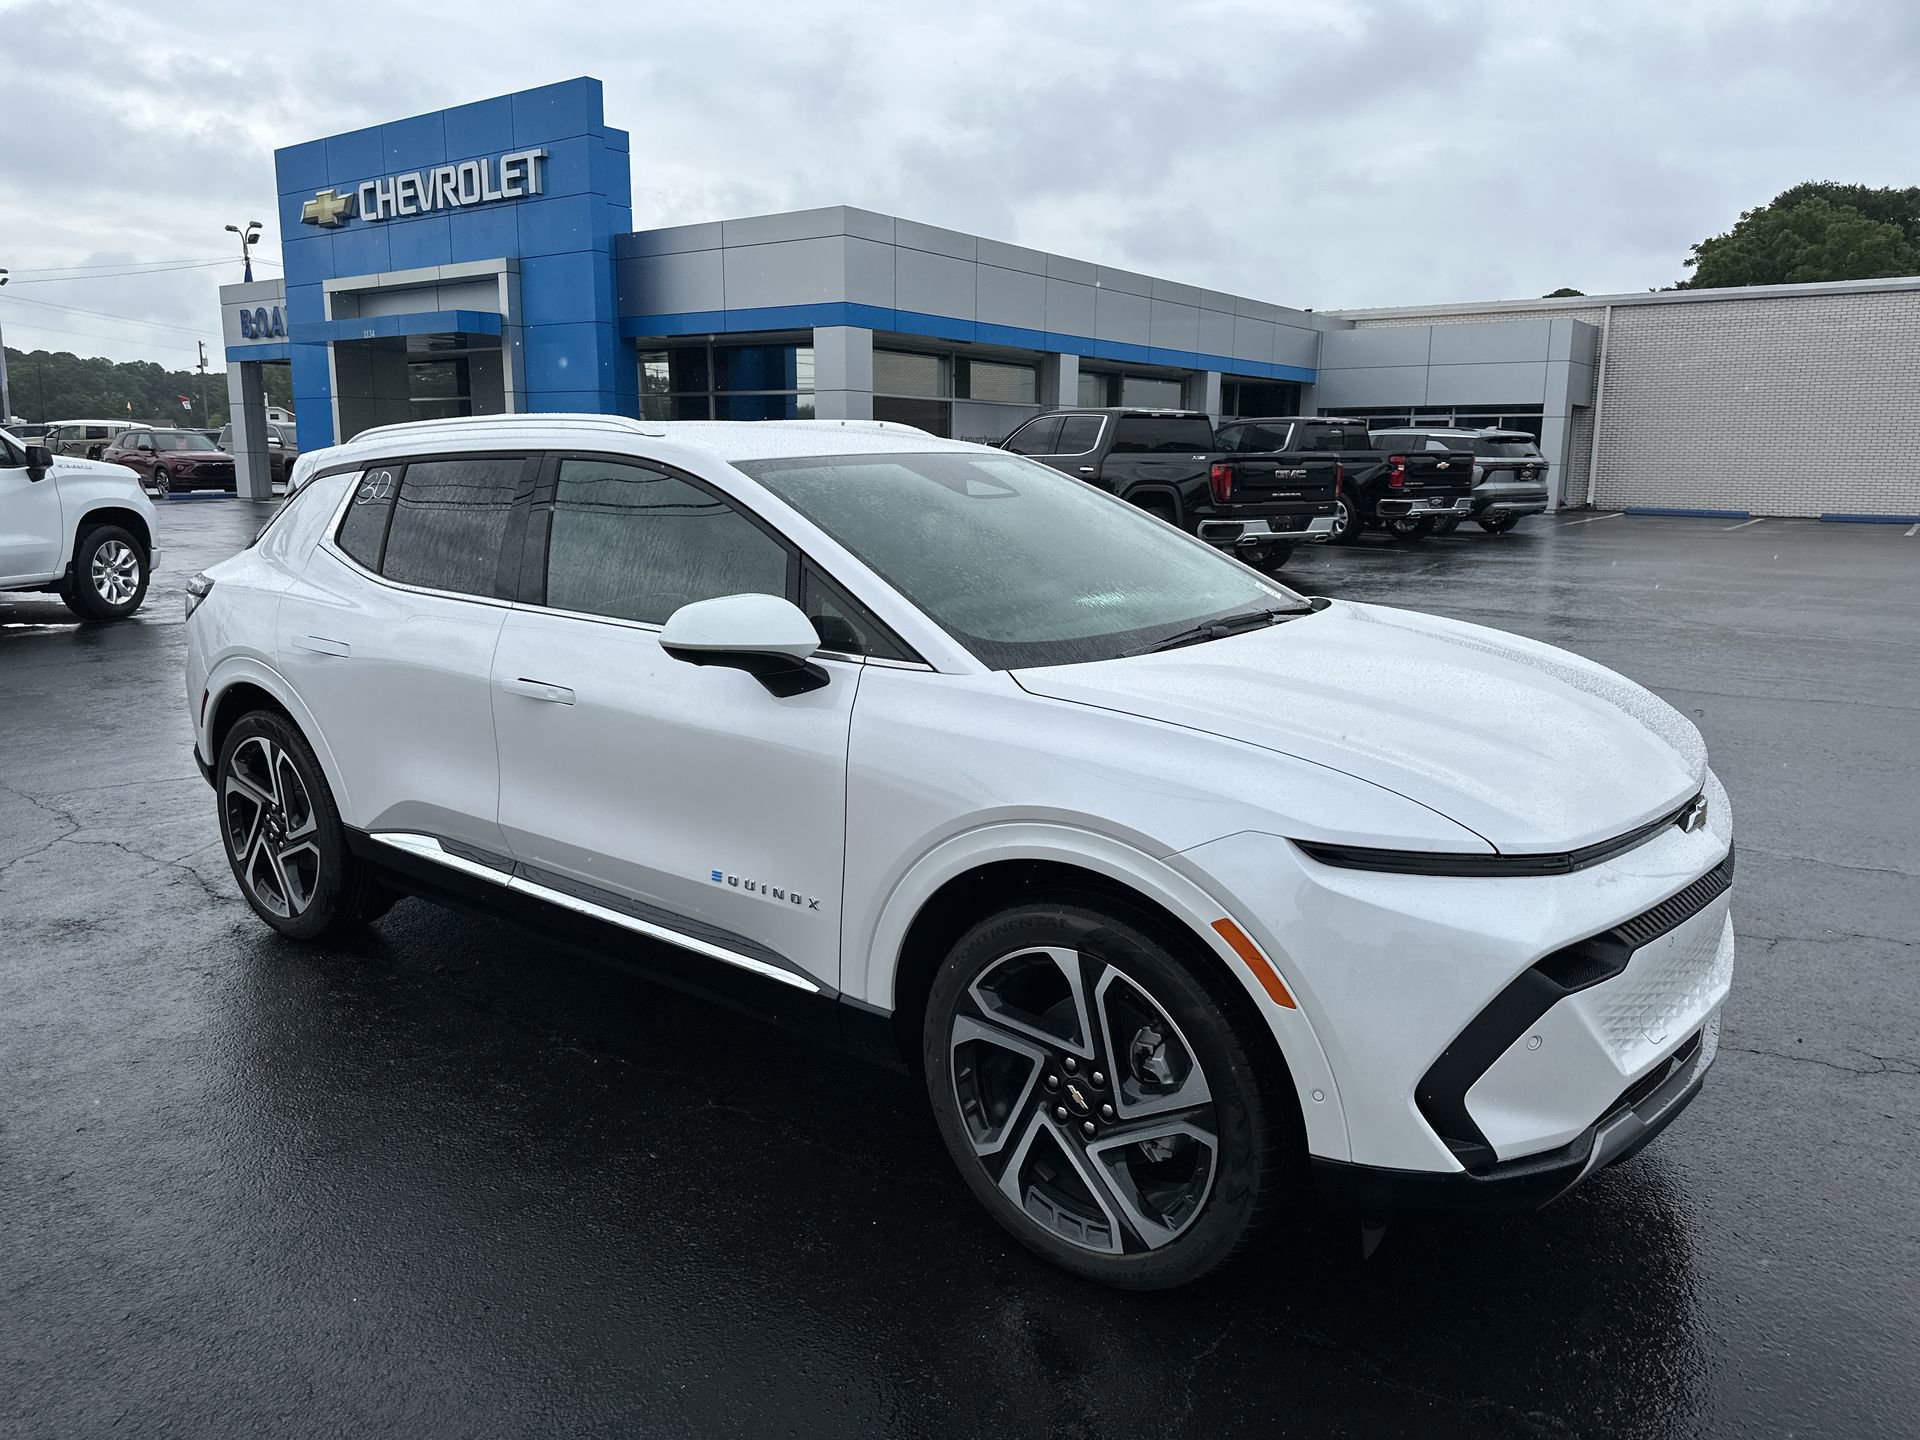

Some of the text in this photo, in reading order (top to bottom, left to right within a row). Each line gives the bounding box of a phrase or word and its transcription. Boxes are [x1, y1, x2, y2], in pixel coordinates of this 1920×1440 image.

[358, 148, 545, 222] CHEVROLET
[240, 305, 289, 339] BOA
[1275, 469, 1307, 479] GMC
[711, 868, 820, 912] EQUINOX
